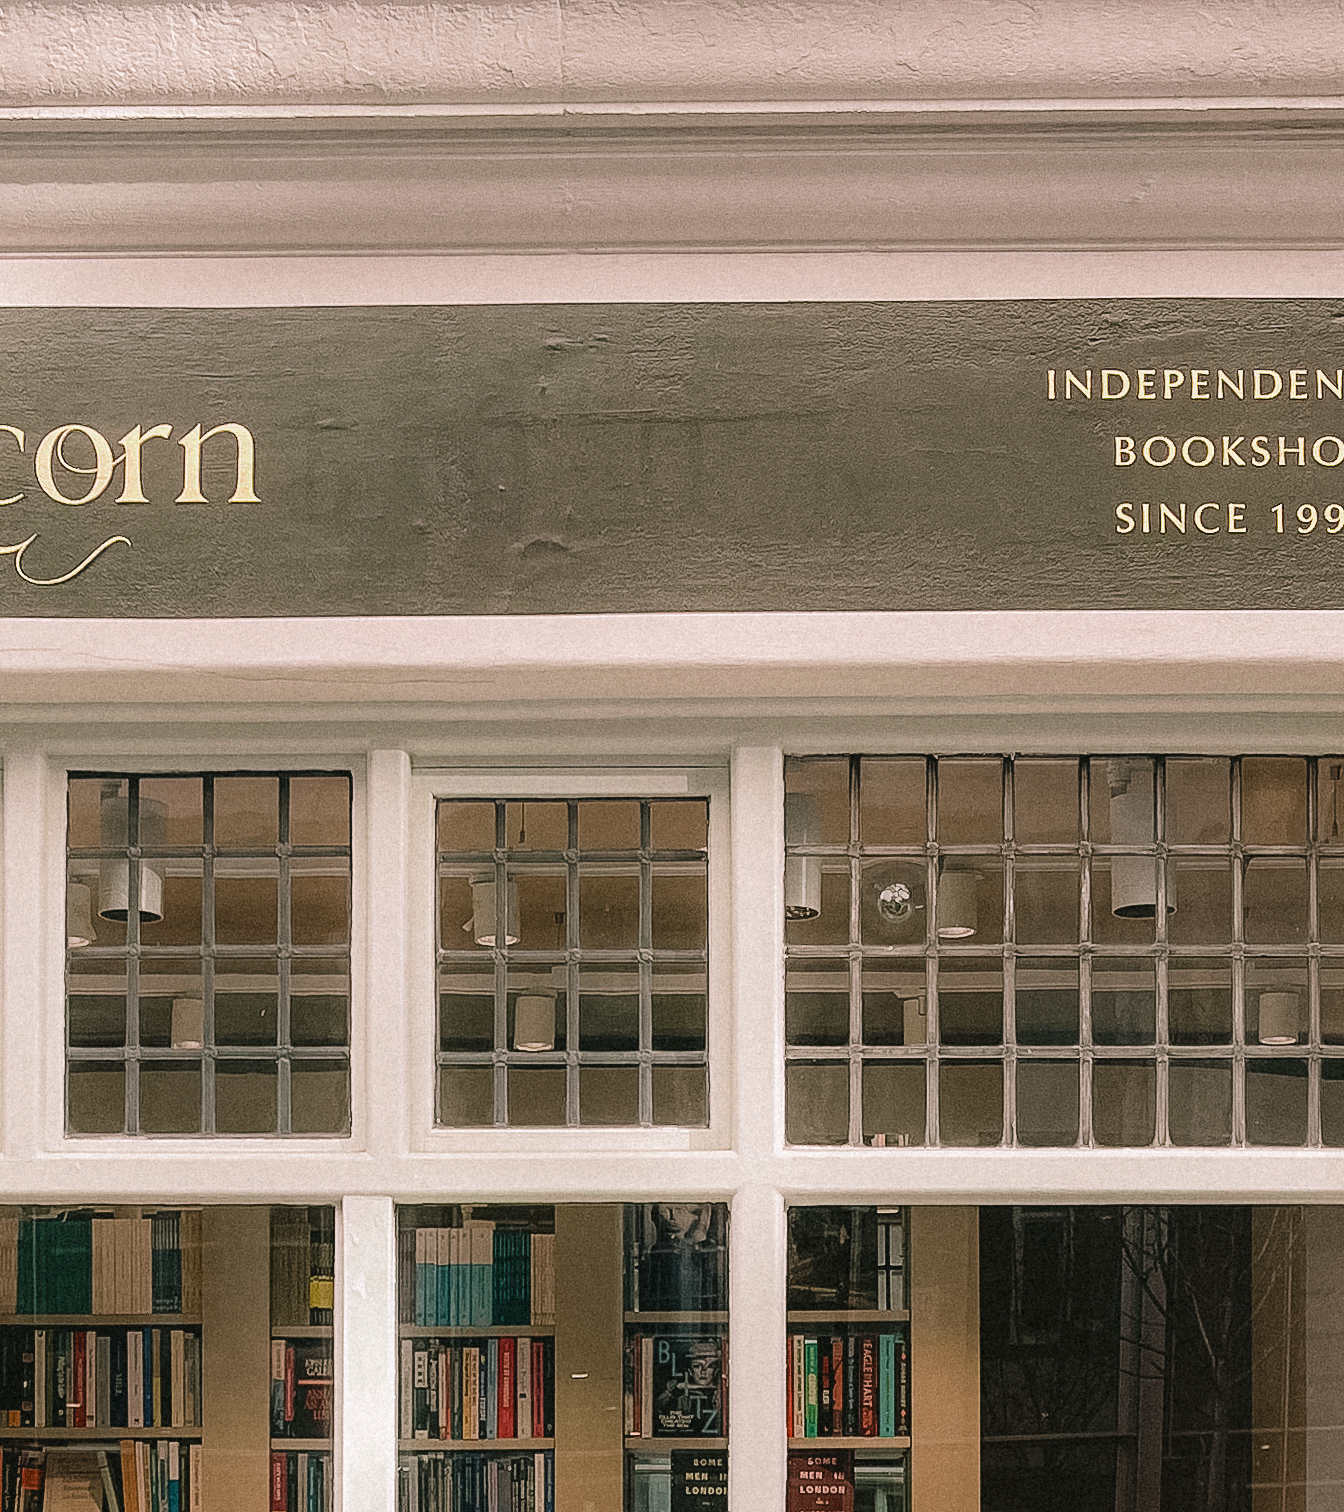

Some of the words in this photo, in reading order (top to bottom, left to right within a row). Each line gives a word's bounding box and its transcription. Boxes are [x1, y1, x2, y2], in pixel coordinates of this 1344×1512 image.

[1115, 502, 1249, 534] SINCE
[693, 1457, 723, 1467] SOME
[807, 1457, 837, 1466] SOME
[685, 1472, 708, 1482] MEN
[799, 1471, 823, 1481] MEN
[799, 1485, 846, 1495] LONDON
